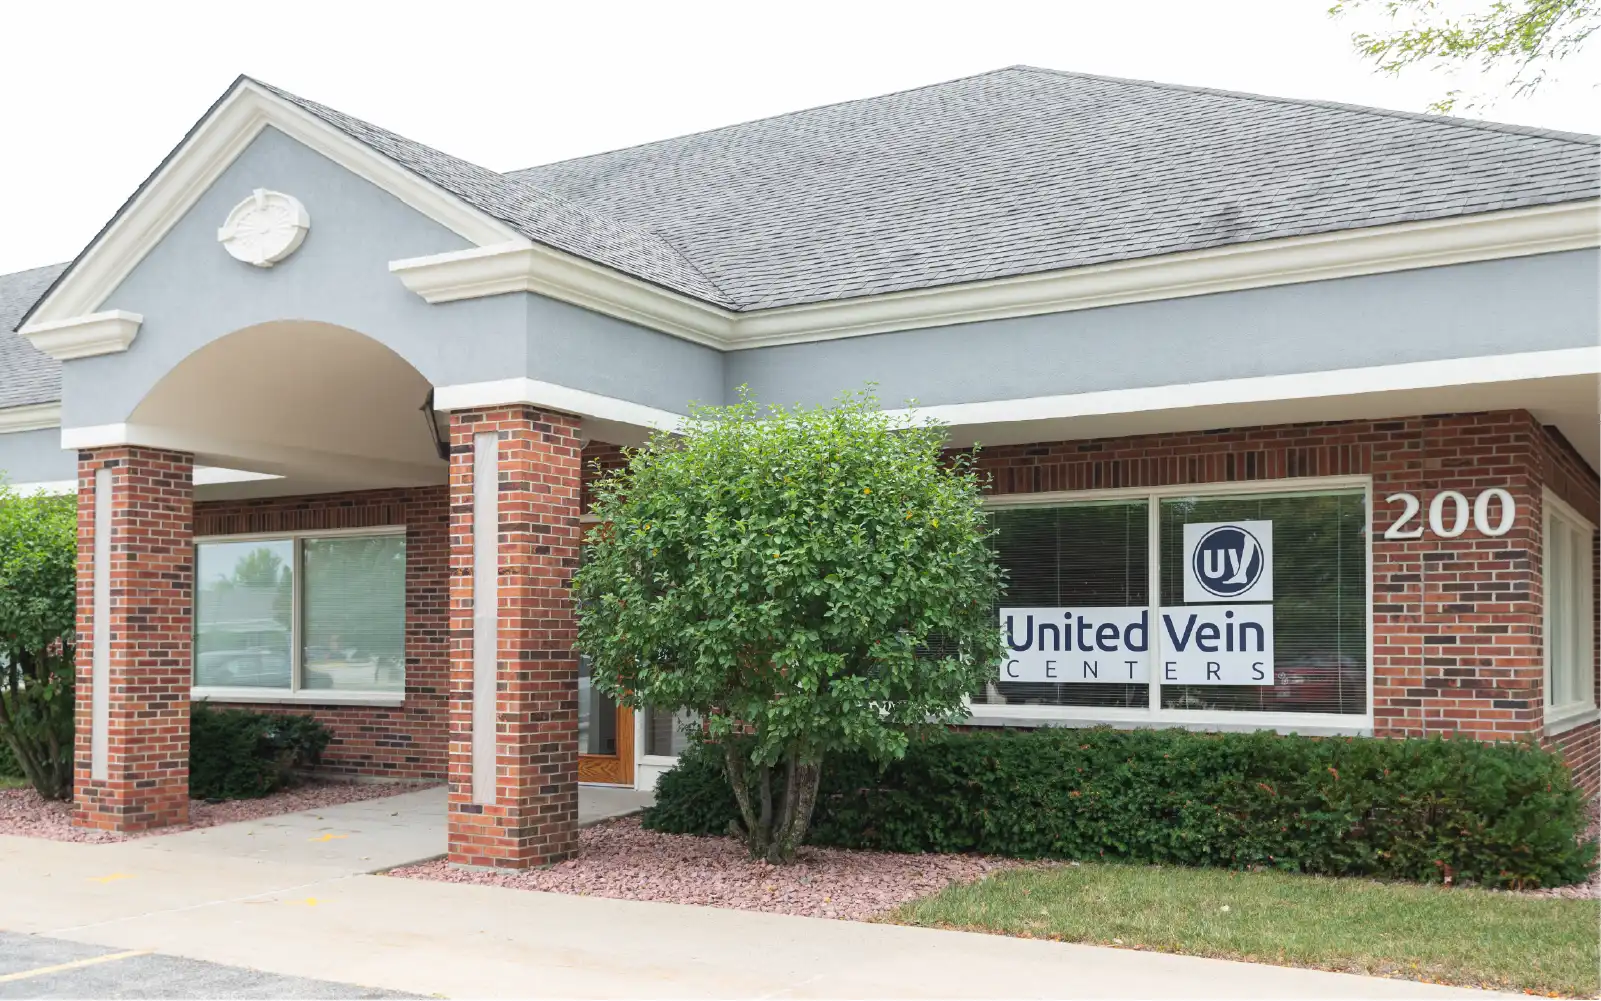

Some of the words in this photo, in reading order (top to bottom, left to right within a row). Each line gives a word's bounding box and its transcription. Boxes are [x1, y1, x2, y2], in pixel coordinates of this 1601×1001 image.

[1384, 488, 1515, 540] 200
[1006, 610, 1149, 652] United
[1162, 610, 1264, 652] Vein
[1006, 659, 1266, 681] CENTERS
